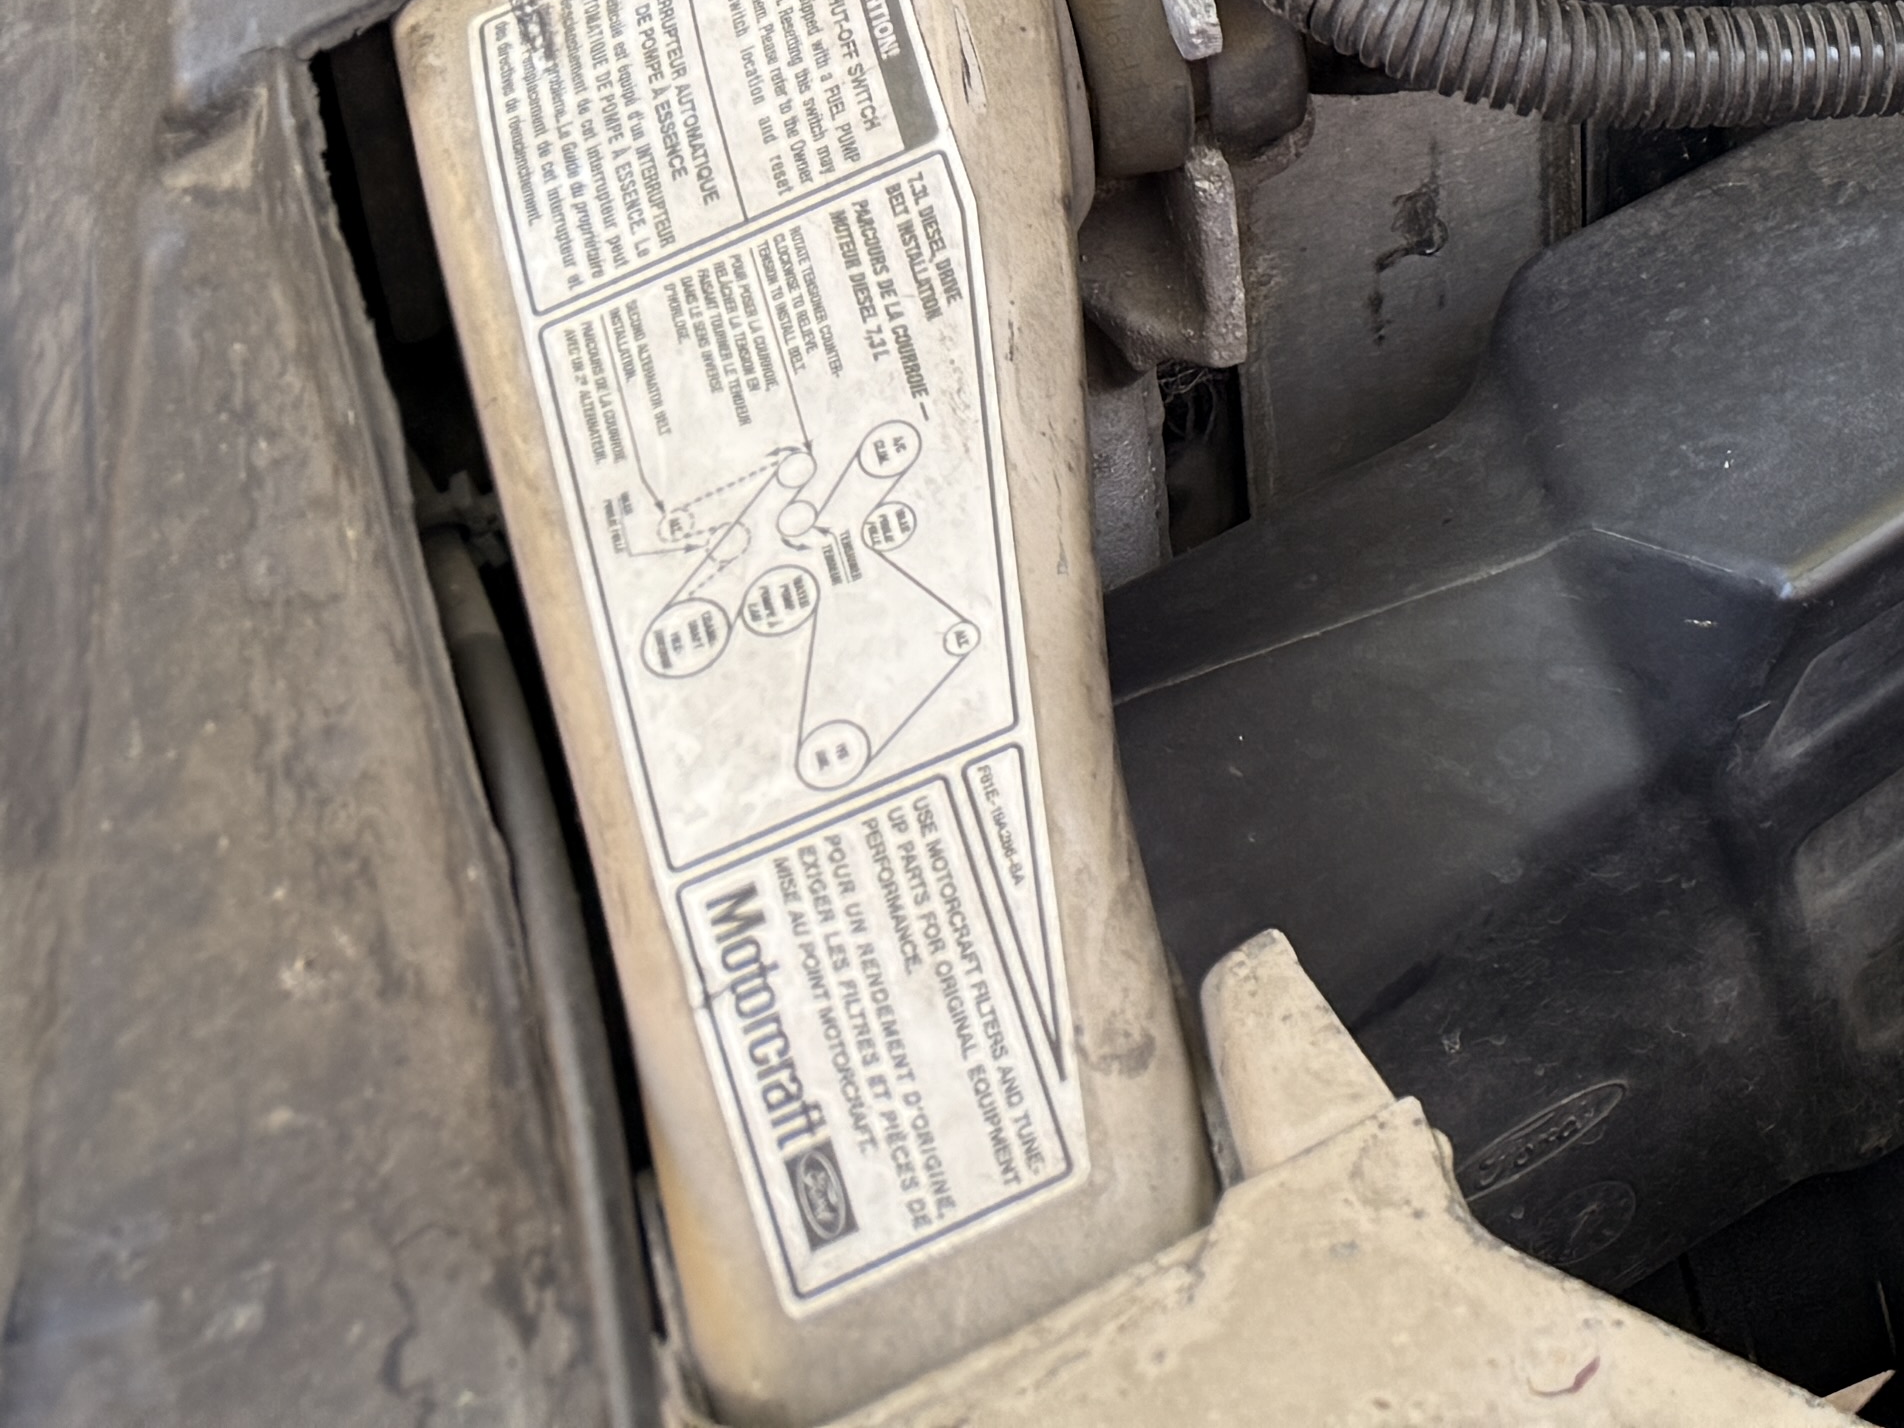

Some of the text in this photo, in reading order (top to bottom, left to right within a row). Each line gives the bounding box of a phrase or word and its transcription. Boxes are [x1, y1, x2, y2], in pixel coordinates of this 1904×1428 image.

[846, 61, 881, 133] SWITCH
[676, 80, 718, 206] AUTOMATIQUE
[850, 197, 888, 277] PARCOURS
[885, 182, 942, 323] BELT INSTALLATION
[906, 172, 962, 305] 7.3L DIESEL DRIVE
[876, 275, 898, 300] DE
[883, 299, 904, 322] LA
[890, 321, 929, 402] COURROIE
[796, 842, 836, 926] EXIGER
[822, 831, 857, 898] POUR
[860, 815, 924, 977] PERFORMANCE.
[822, 928, 851, 974] LES
[841, 899, 868, 938] UN
[707, 882, 825, 1150] Motorcraft
[836, 973, 881, 1069] FILTRES
[854, 938, 916, 1088] RENDEMENT
[885, 805, 1022, 1191] UP PARTS FOR ORIGINAL EQUIPMENT
[910, 794, 1047, 1178] USE MOTORCRAFT FILTERS AND TUNE-
[865, 1069, 892, 1106] ET
[904, 1193, 933, 1233] DE
